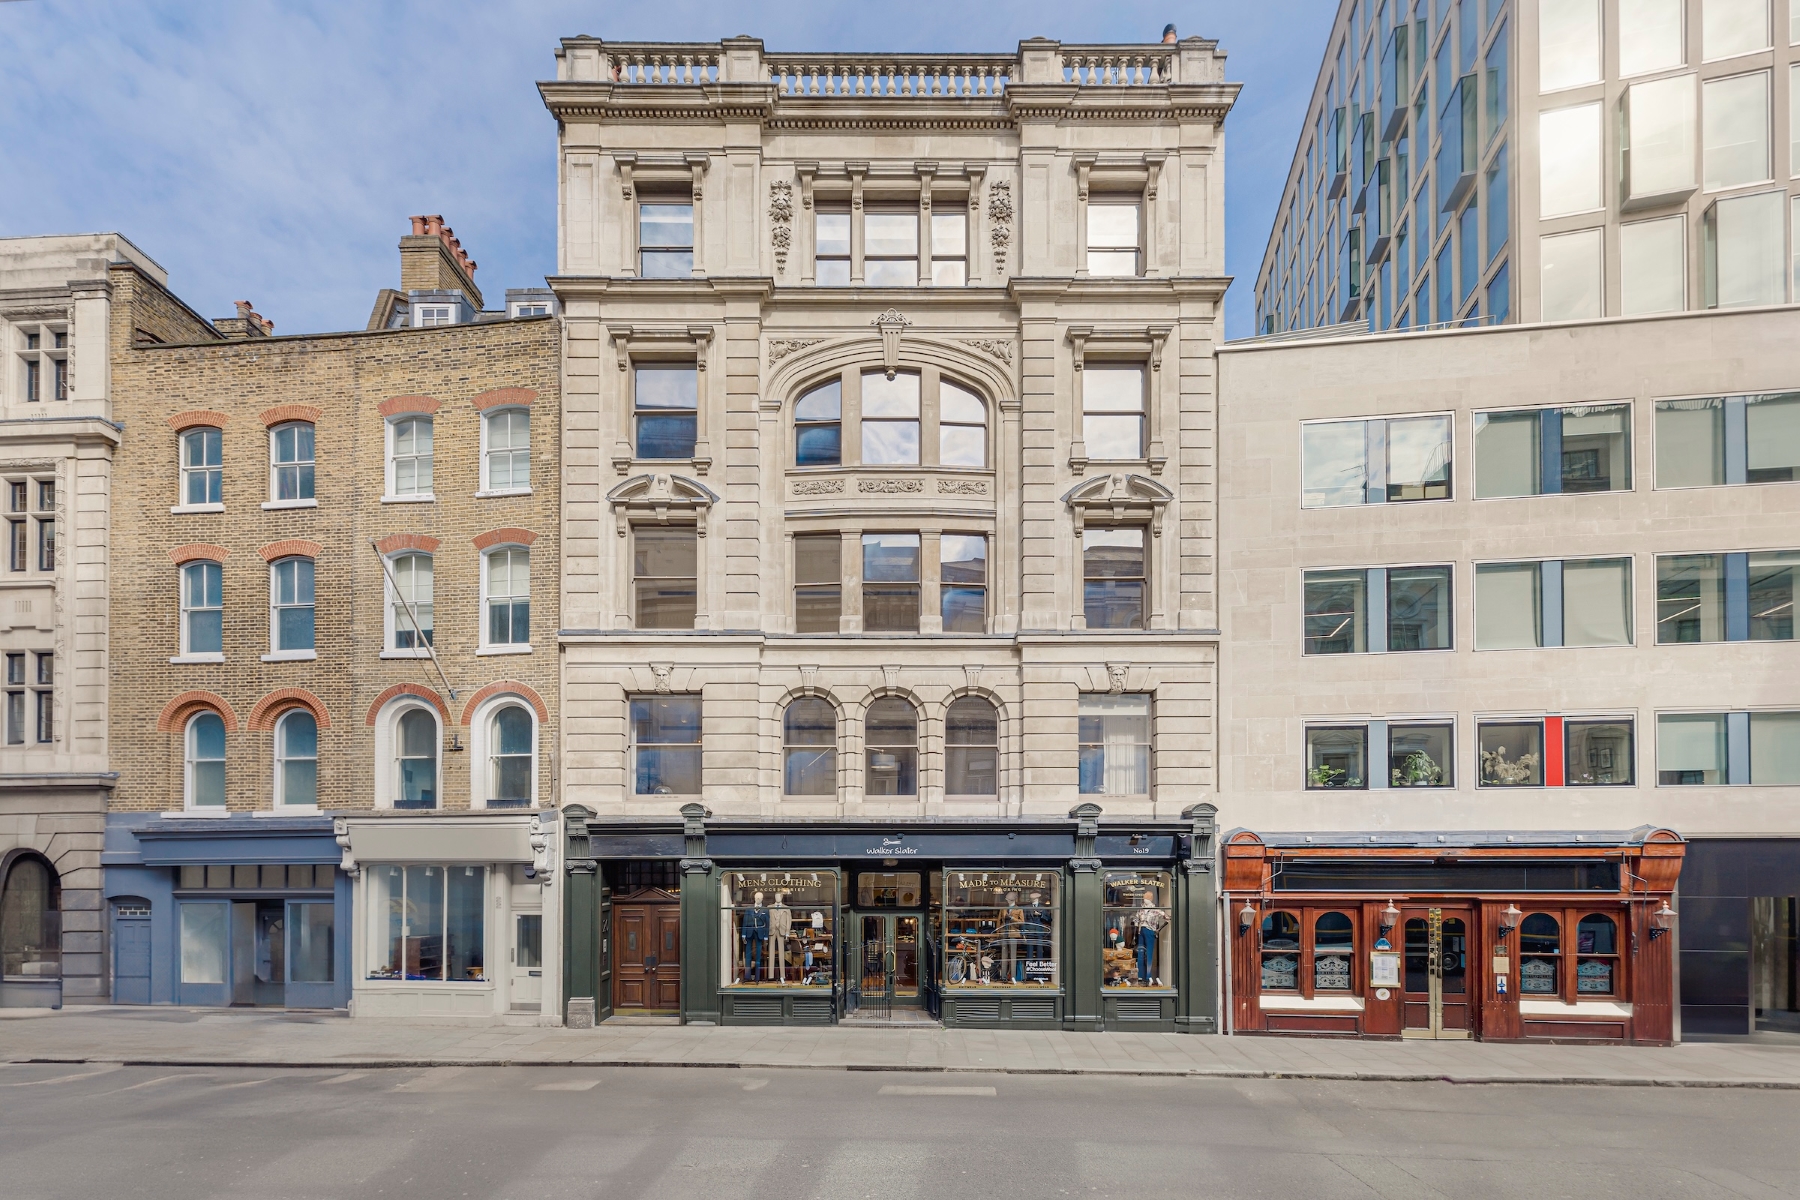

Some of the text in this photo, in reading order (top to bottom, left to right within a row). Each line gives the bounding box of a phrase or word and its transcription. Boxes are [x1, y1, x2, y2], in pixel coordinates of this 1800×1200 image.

[894, 847, 918, 855] Slater
[738, 878, 822, 889] MENS CLOTHING
[959, 880, 988, 889] MADE
[1000, 879, 1047, 889] MEASURE
[1109, 879, 1166, 889] WALKER SLATER
